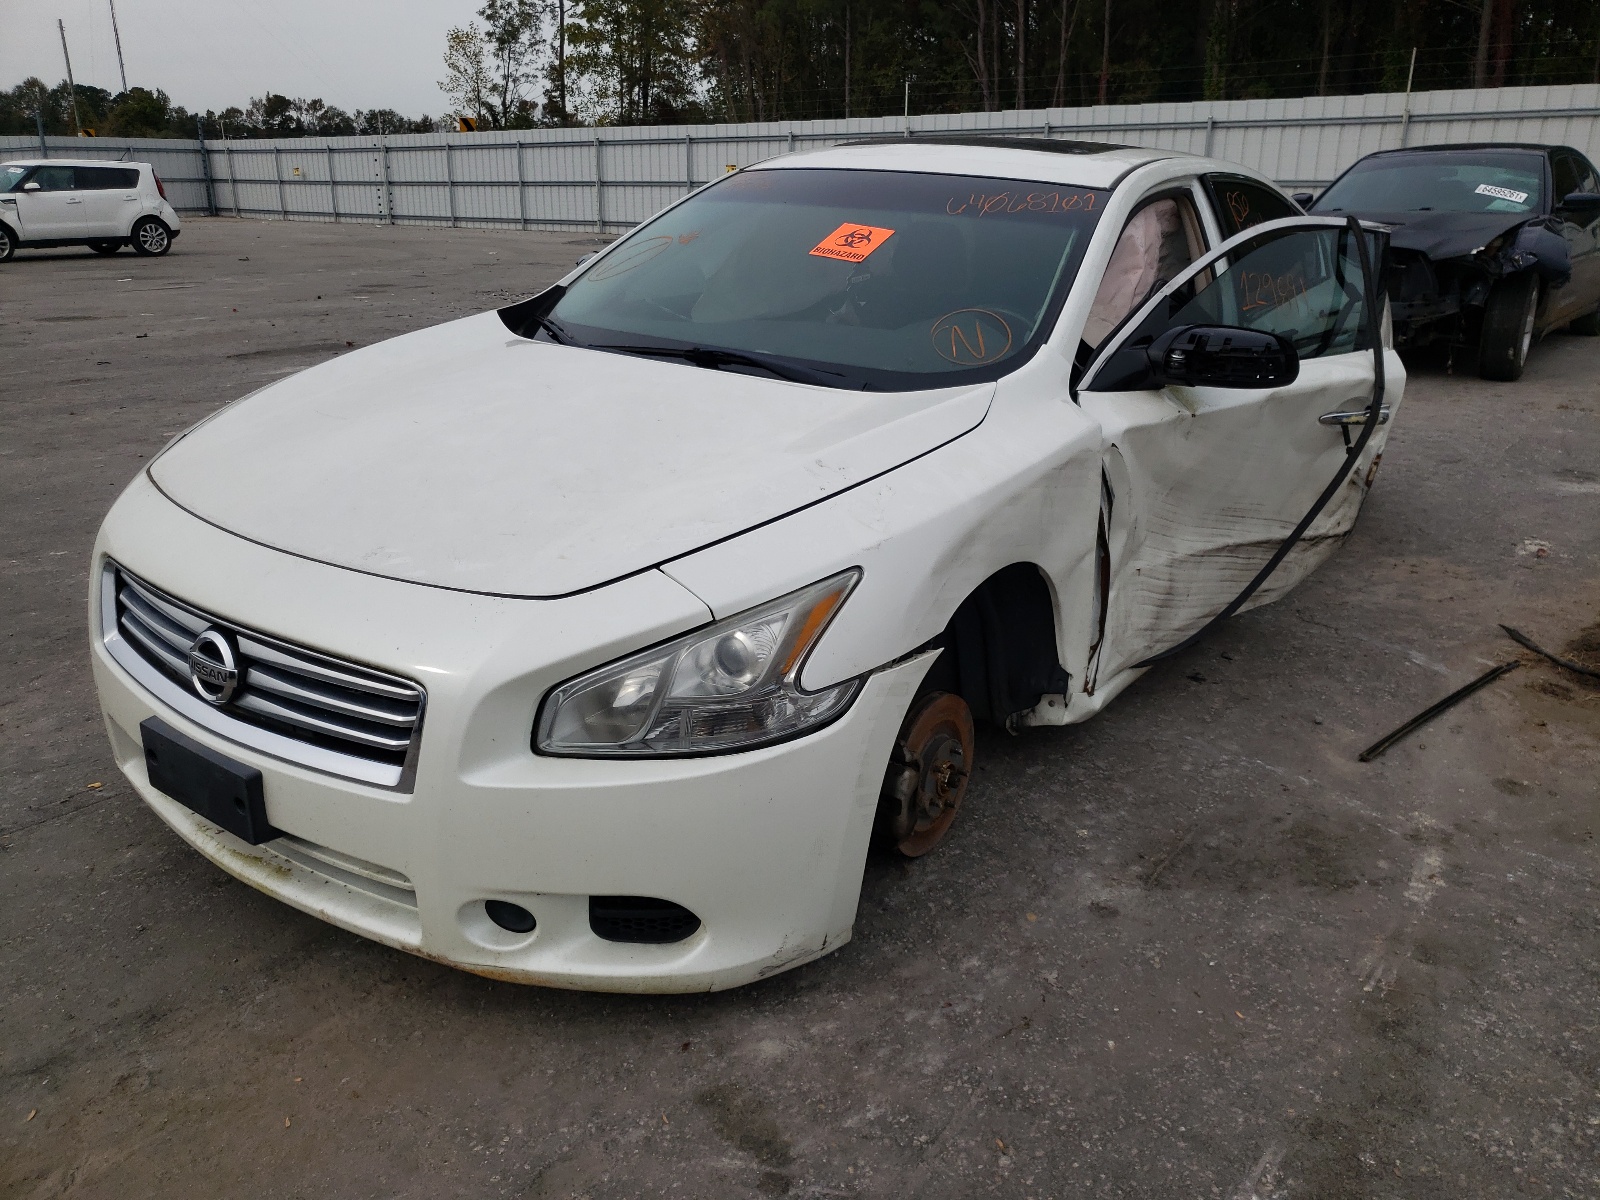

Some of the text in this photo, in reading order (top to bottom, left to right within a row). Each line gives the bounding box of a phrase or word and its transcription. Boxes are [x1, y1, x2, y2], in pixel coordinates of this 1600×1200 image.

[812, 246, 865, 261] BIOHAZARD
[950, 318, 986, 359] N
[188, 656, 228, 683] NISSAN
